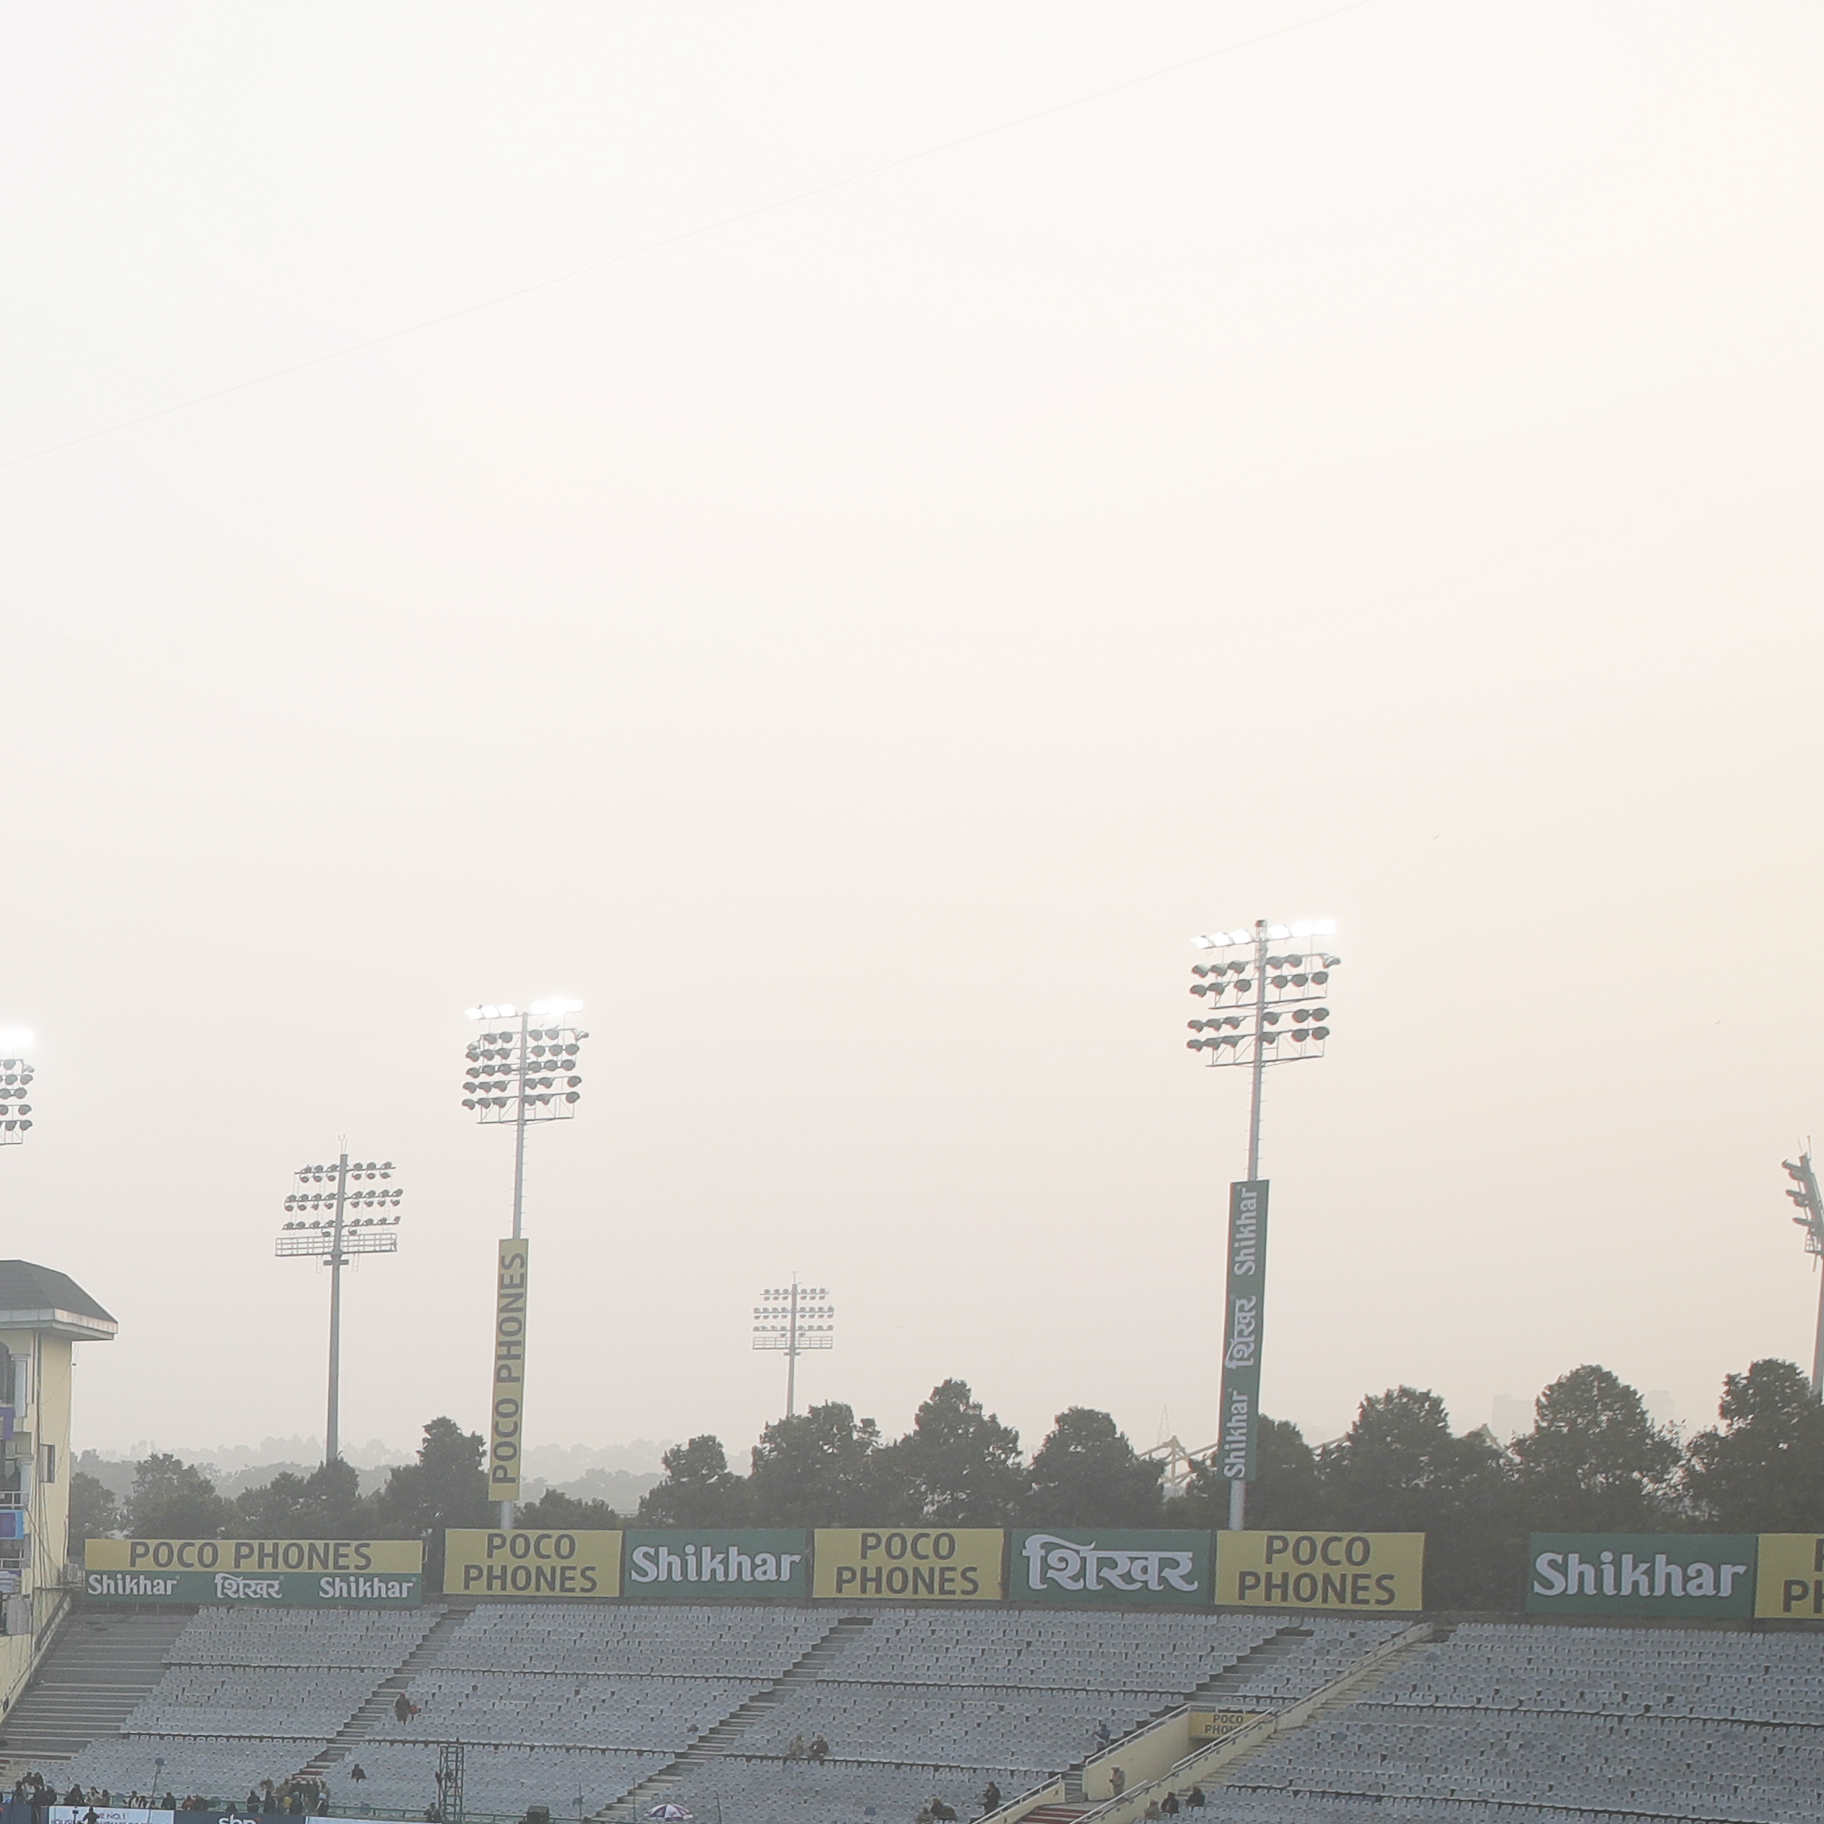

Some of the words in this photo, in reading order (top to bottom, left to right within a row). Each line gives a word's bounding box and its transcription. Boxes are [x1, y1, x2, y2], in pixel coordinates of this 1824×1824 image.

[1234, 1188, 1257, 1276] Shikhar
[496, 1253, 524, 1383] PHONES
[492, 1398, 519, 1484] POCO
[1223, 1391, 1248, 1479] Shikhar
[129, 1542, 219, 1569] POCO
[234, 1542, 372, 1571] PHONES
[486, 1533, 576, 1560] POCO
[860, 1533, 956, 1561] POCO
[1022, 1534, 1200, 1592] शिखर
[1265, 1535, 1370, 1566] POCO
[463, 1564, 597, 1593] PHONES
[631, 1545, 802, 1584] Shikhar
[835, 1566, 980, 1595] PHONES
[1532, 1551, 1747, 1599] Shikhar
[87, 1575, 176, 1597] Shikhar
[319, 1576, 414, 1599] Shikhar
[1237, 1570, 1395, 1605] PHONES
